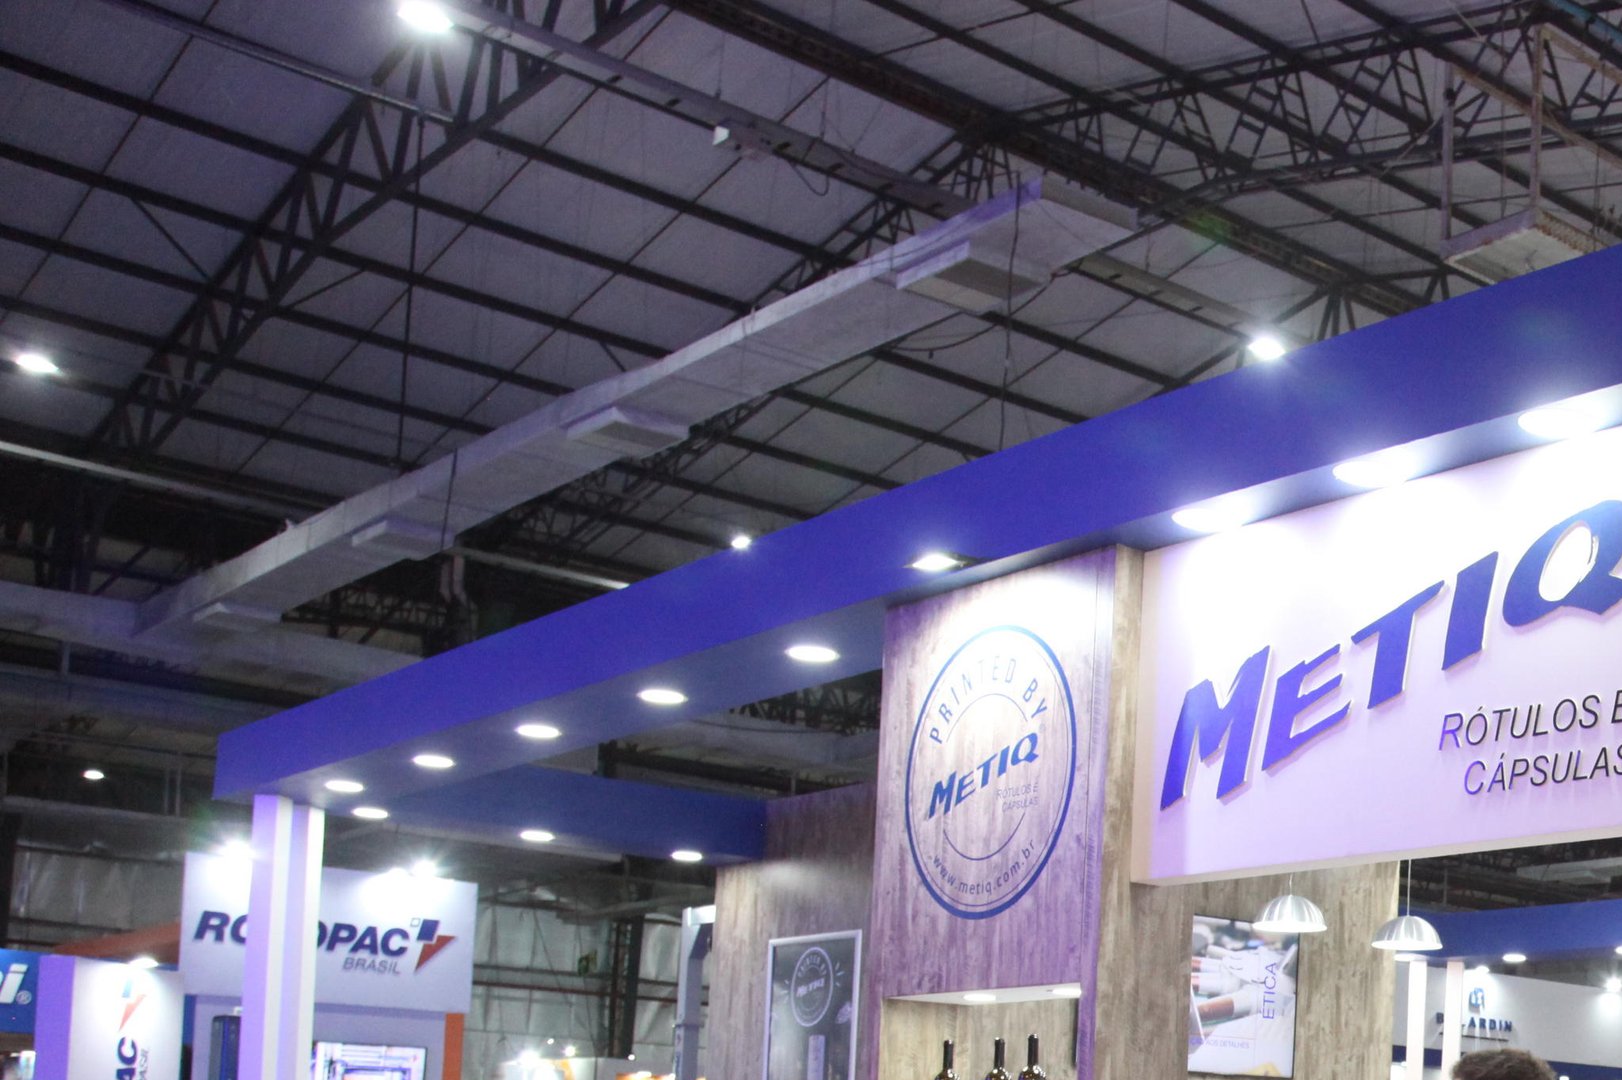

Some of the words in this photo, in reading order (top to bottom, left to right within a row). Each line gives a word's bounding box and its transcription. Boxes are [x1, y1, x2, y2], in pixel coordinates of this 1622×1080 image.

[929, 655, 1017, 744] PRINTED
[1022, 678, 1048, 719] BY
[1438, 694, 1602, 752] RÓTULOS
[928, 732, 1039, 820] METIQ
[931, 839, 1035, 896] www.metiq.com.br
[193, 909, 410, 957] ROPAC
[341, 956, 401, 976] BRASIL
[1435, 1011, 1512, 1032] BARDIN
